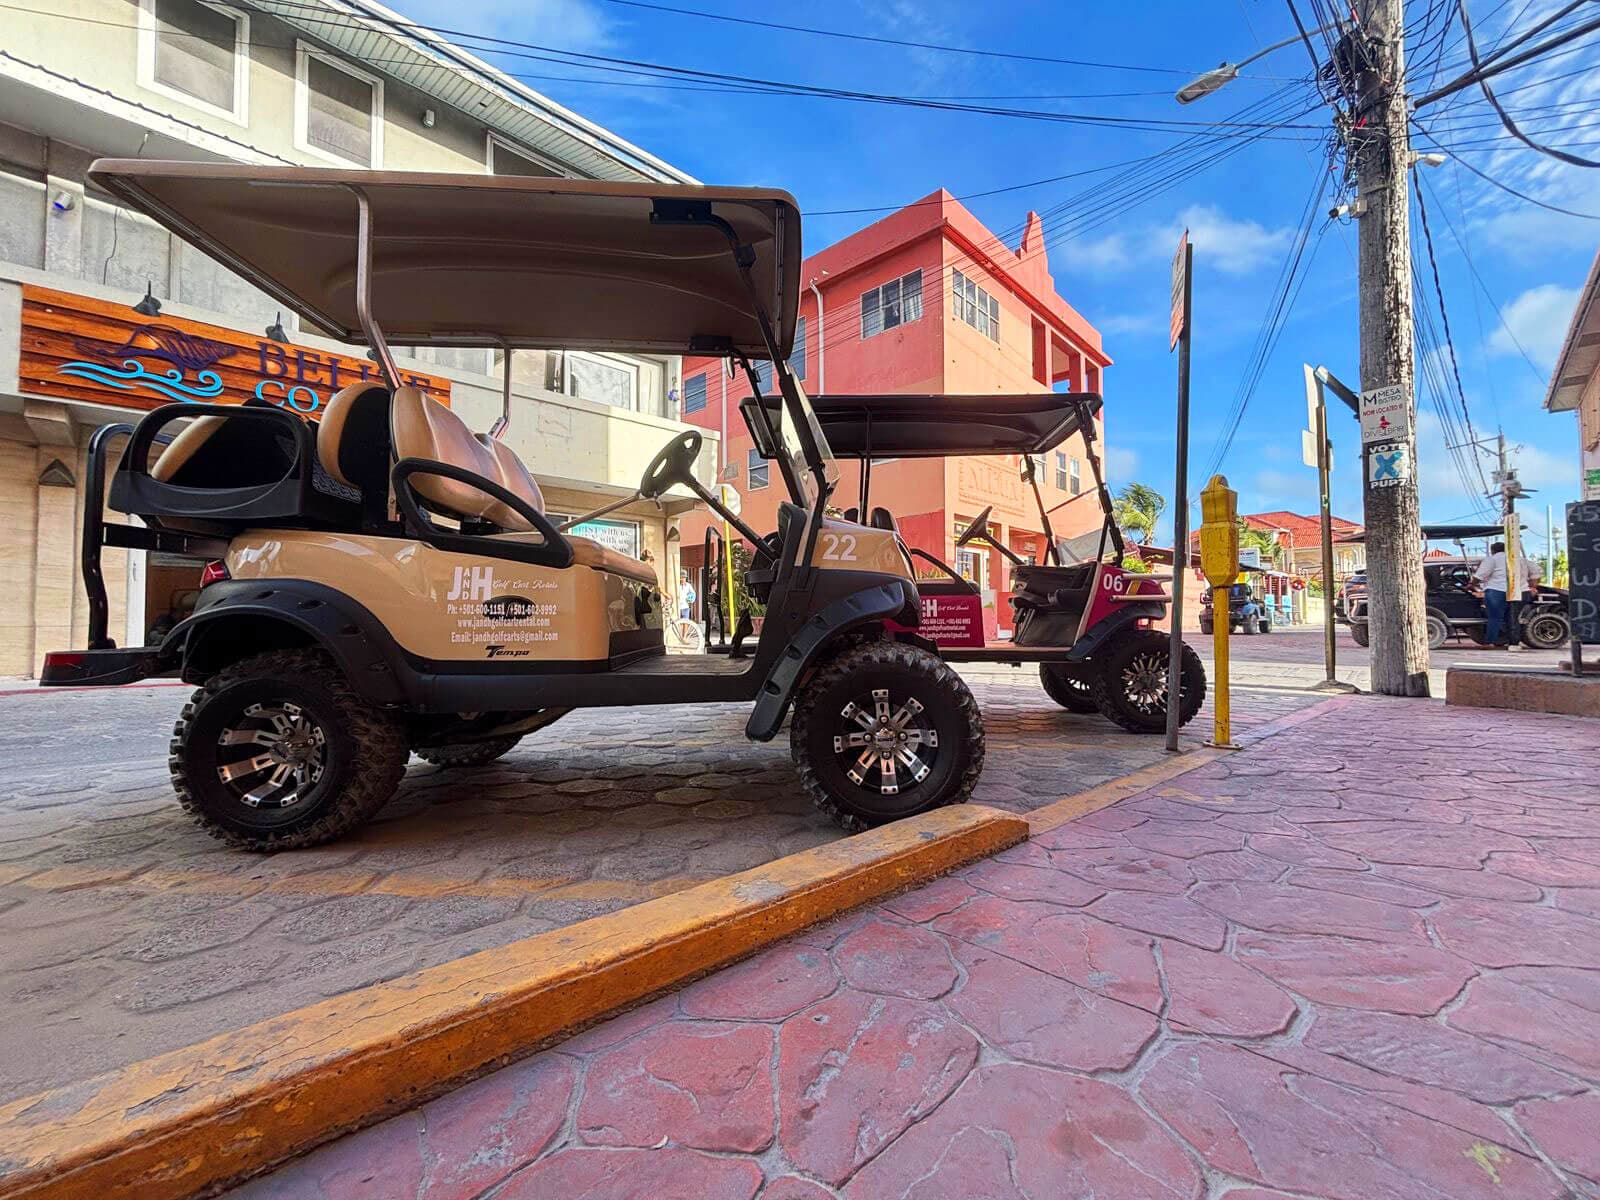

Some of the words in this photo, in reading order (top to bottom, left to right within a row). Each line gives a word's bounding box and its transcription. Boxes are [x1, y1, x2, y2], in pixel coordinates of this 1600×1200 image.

[1378, 388, 1402, 398] MESA
[1369, 442, 1410, 454] VOTE
[822, 534, 857, 561] 22
[1103, 573, 1123, 592] 06
[451, 631, 472, 643] Email:
[485, 645, 530, 658] Tempo
